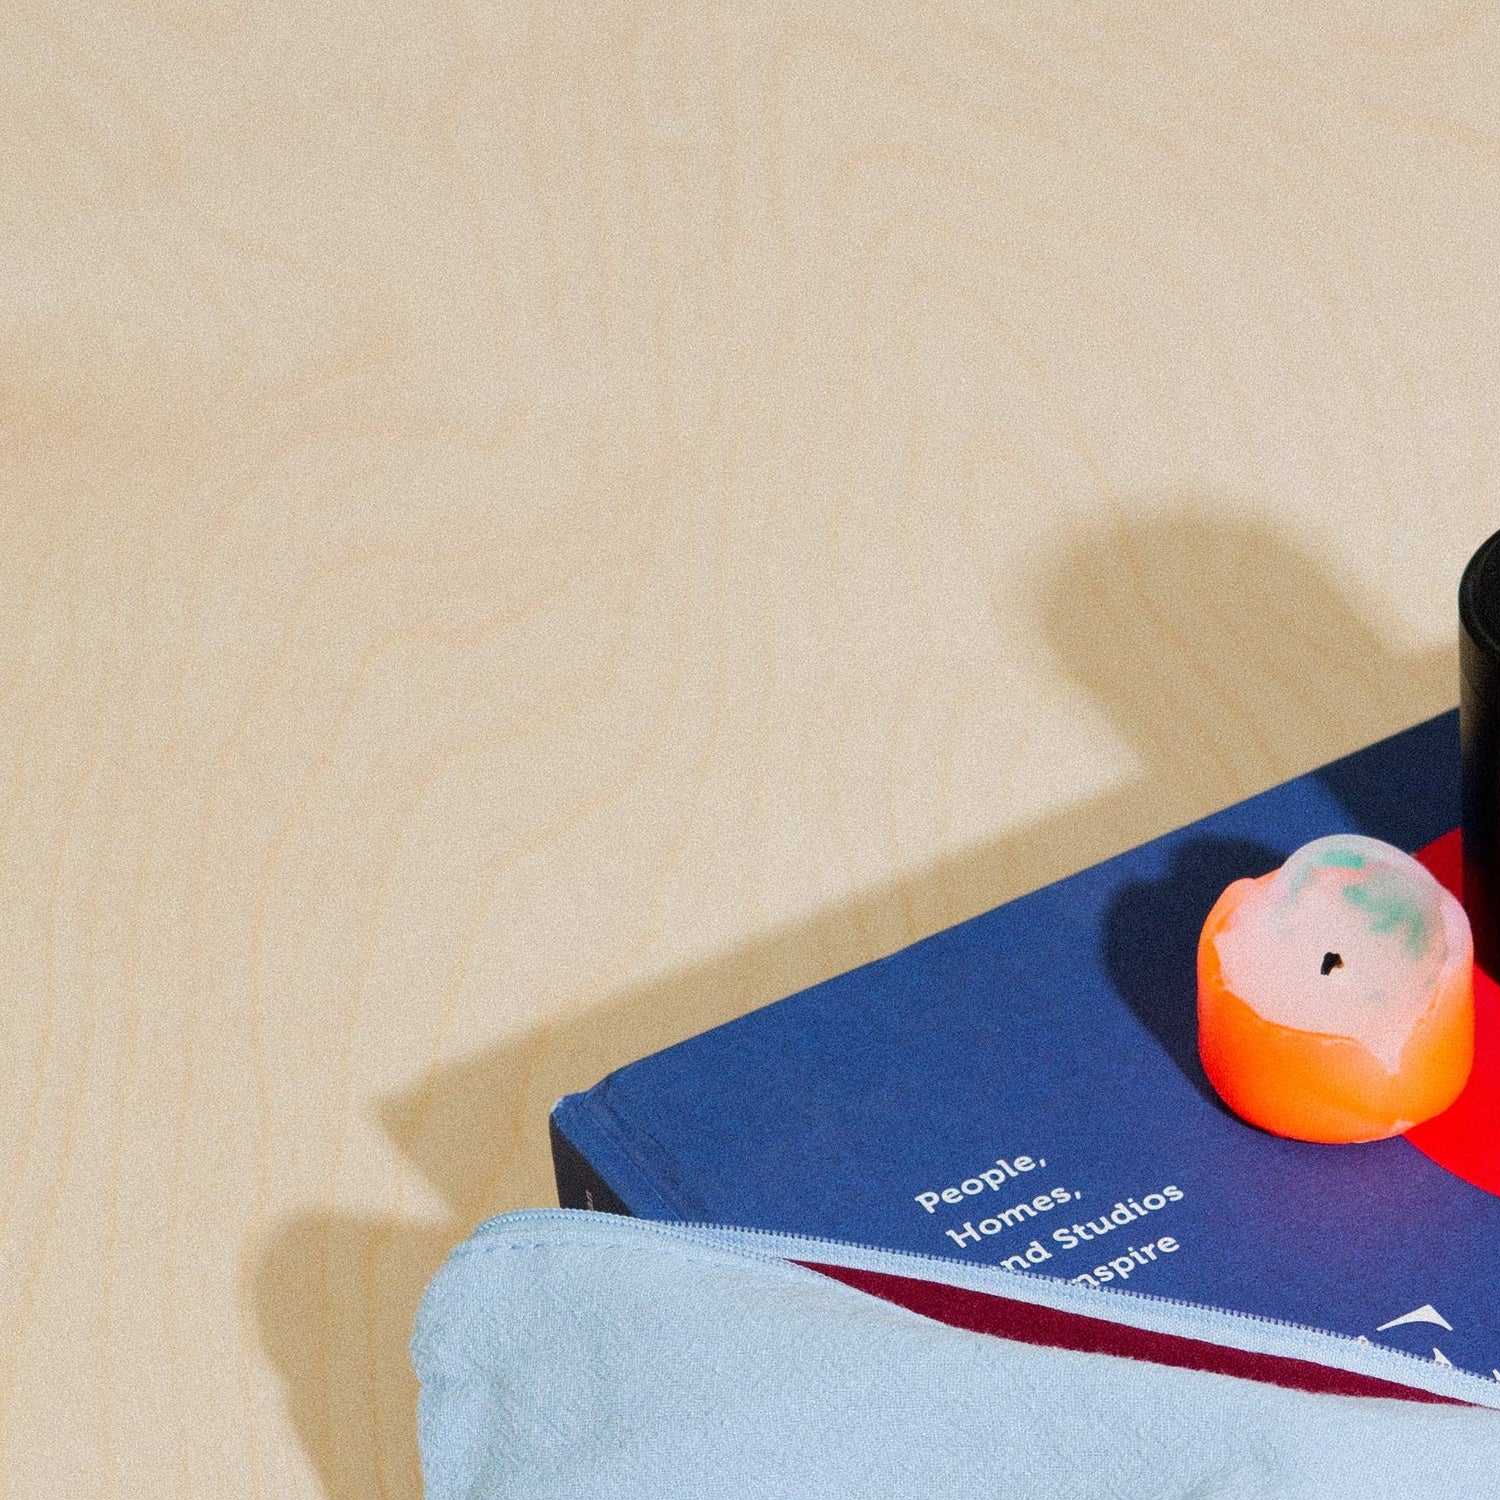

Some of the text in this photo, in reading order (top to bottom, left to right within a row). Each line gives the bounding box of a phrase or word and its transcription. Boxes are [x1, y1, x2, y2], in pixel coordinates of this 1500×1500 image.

[914, 1155, 1046, 1214] People,
[945, 1186, 1082, 1248] Homes,
[1052, 1184, 1184, 1249] Studios
